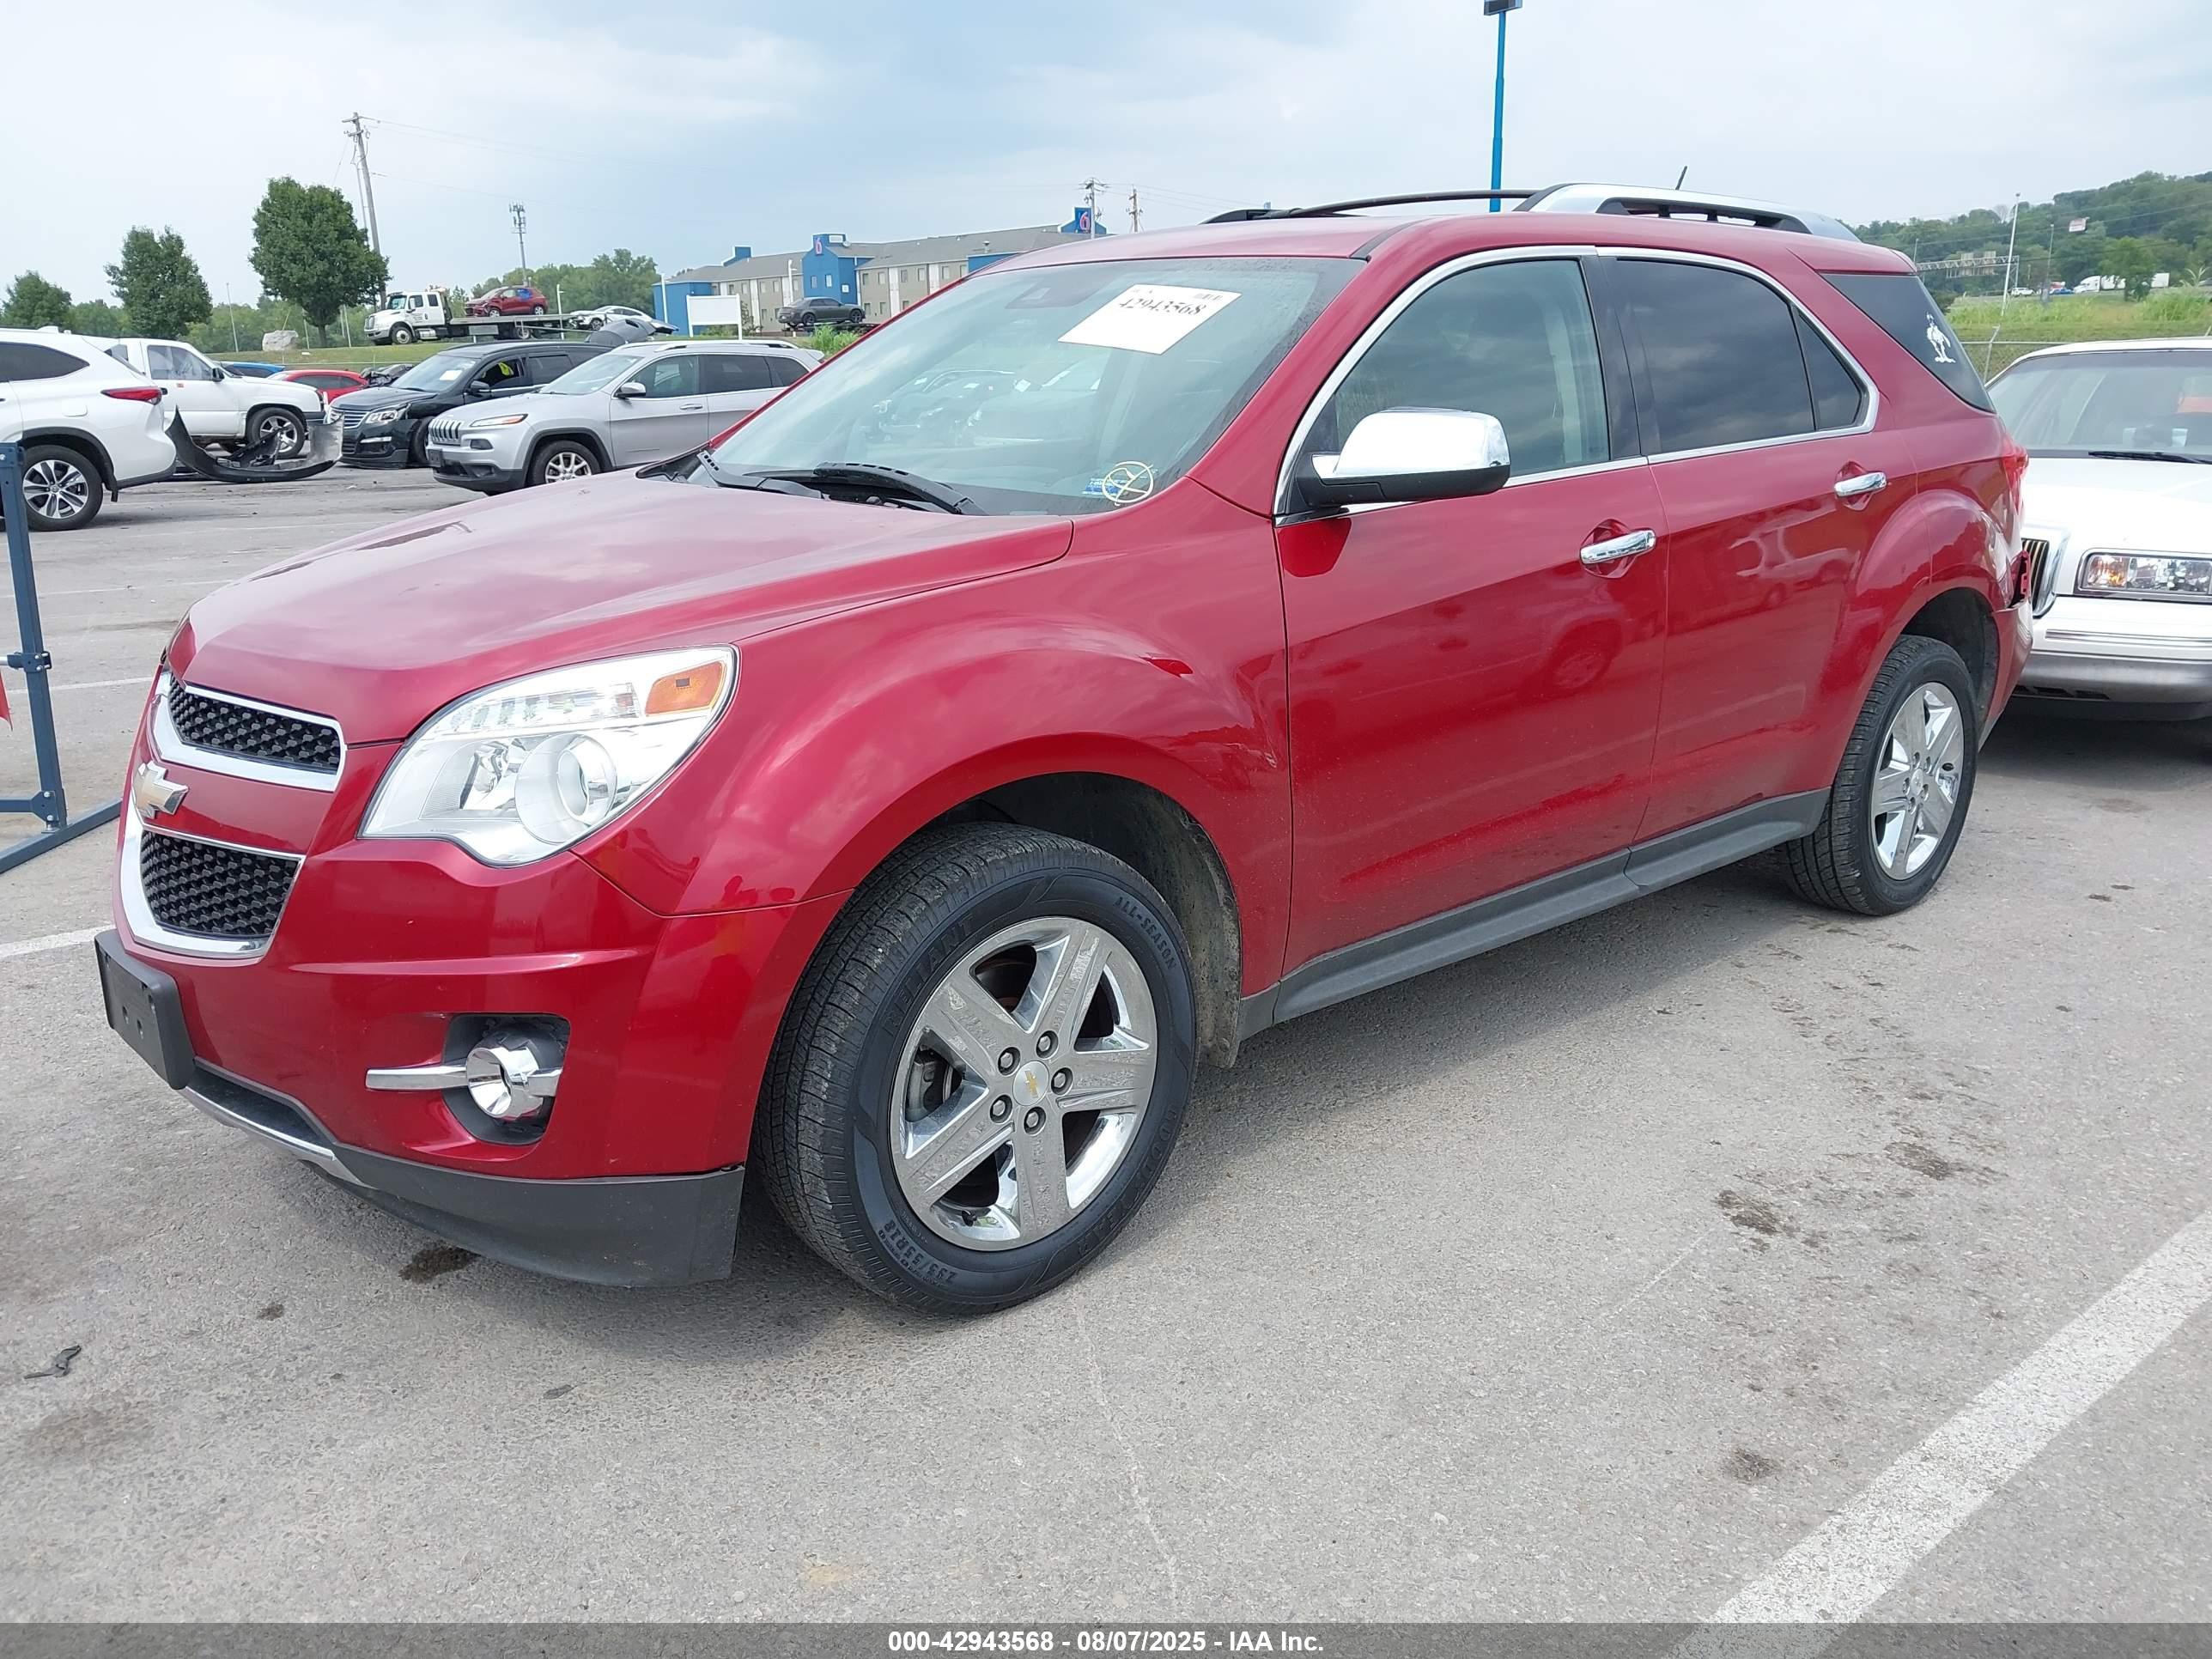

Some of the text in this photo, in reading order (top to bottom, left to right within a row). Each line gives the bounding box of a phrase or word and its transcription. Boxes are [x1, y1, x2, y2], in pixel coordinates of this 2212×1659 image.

[816, 237, 823, 255] 6
[1079, 211, 1091, 231] 6
[1113, 896, 1177, 969] ALL-SEASON
[883, 913, 974, 1038] RELIANT
[883, 1218, 959, 1284] 235/55R18
